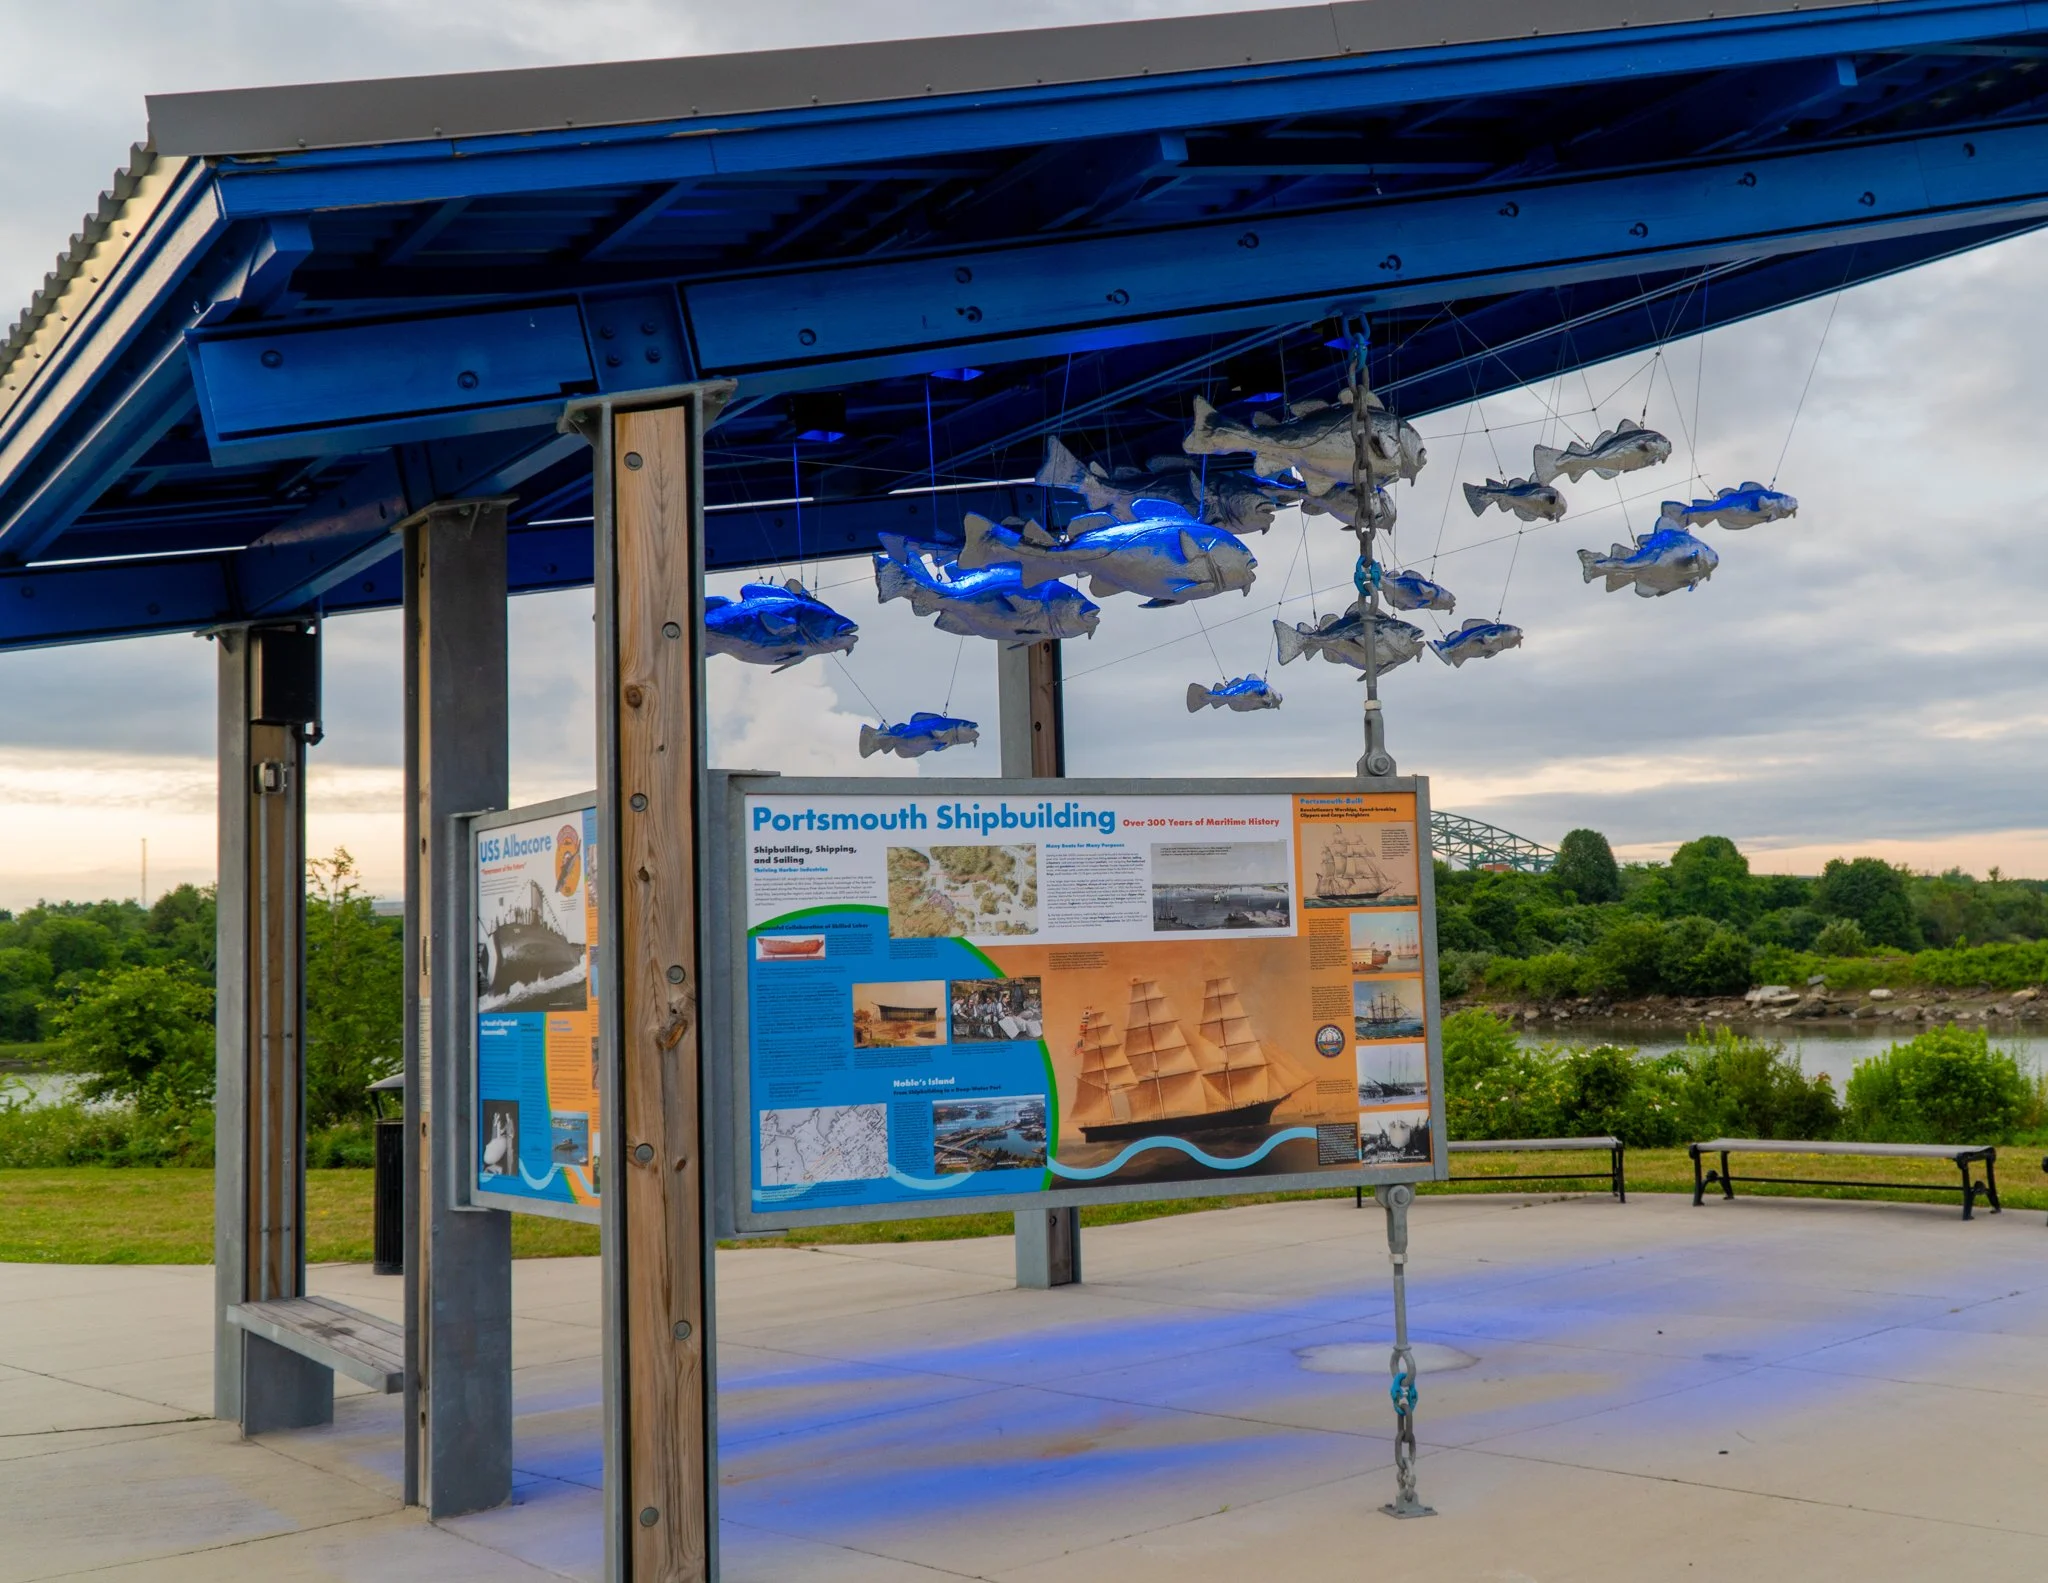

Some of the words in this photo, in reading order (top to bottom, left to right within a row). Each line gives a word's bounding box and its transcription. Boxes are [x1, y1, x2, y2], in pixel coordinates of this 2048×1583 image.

[753, 804, 927, 831] Portsmouth
[937, 803, 1115, 836] Shipbuilding
[1123, 818, 1145, 827] Over
[1147, 818, 1166, 827] 300
[1168, 818, 1193, 827] Years
[1195, 817, 1205, 826] of
[1206, 816, 1247, 826] Maritime
[1248, 816, 1280, 828] History
[480, 839, 501, 863] USS
[503, 834, 552, 859] Albacore
[754, 846, 813, 855] Shipbuilding,
[815, 844, 857, 855] Shipping,
[773, 856, 804, 865] Sailing
[928, 1077, 955, 1085] Island
